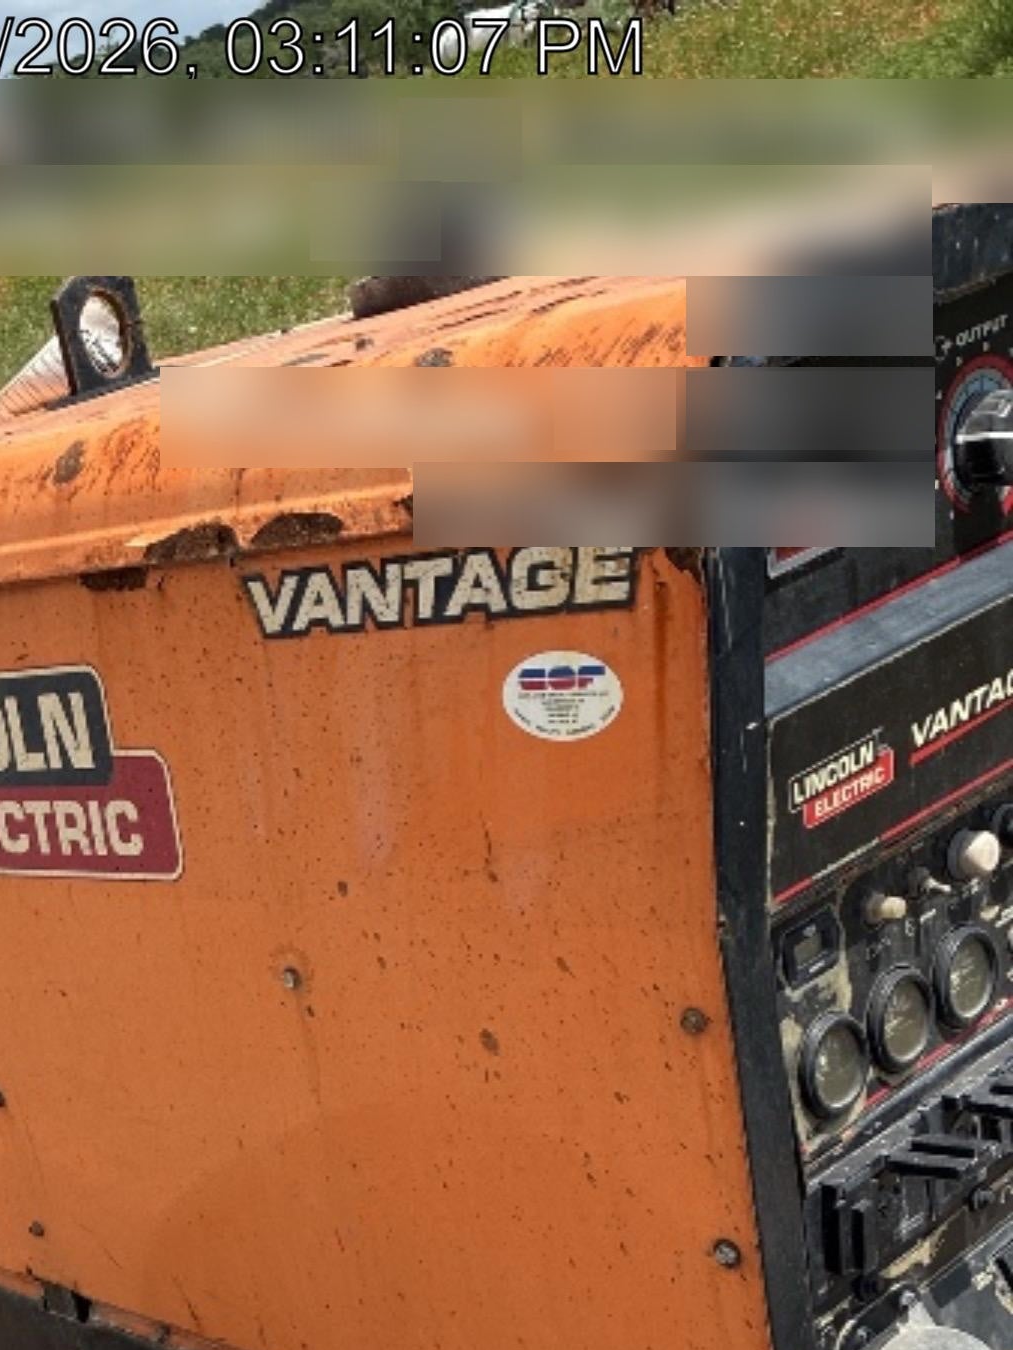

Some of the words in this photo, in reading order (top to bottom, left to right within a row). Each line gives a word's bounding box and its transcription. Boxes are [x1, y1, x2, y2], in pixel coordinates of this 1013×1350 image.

[244, 547, 635, 637] VANTAGE
[793, 741, 874, 802] LINCOLN
[814, 767, 886, 817] ELECTRIC
